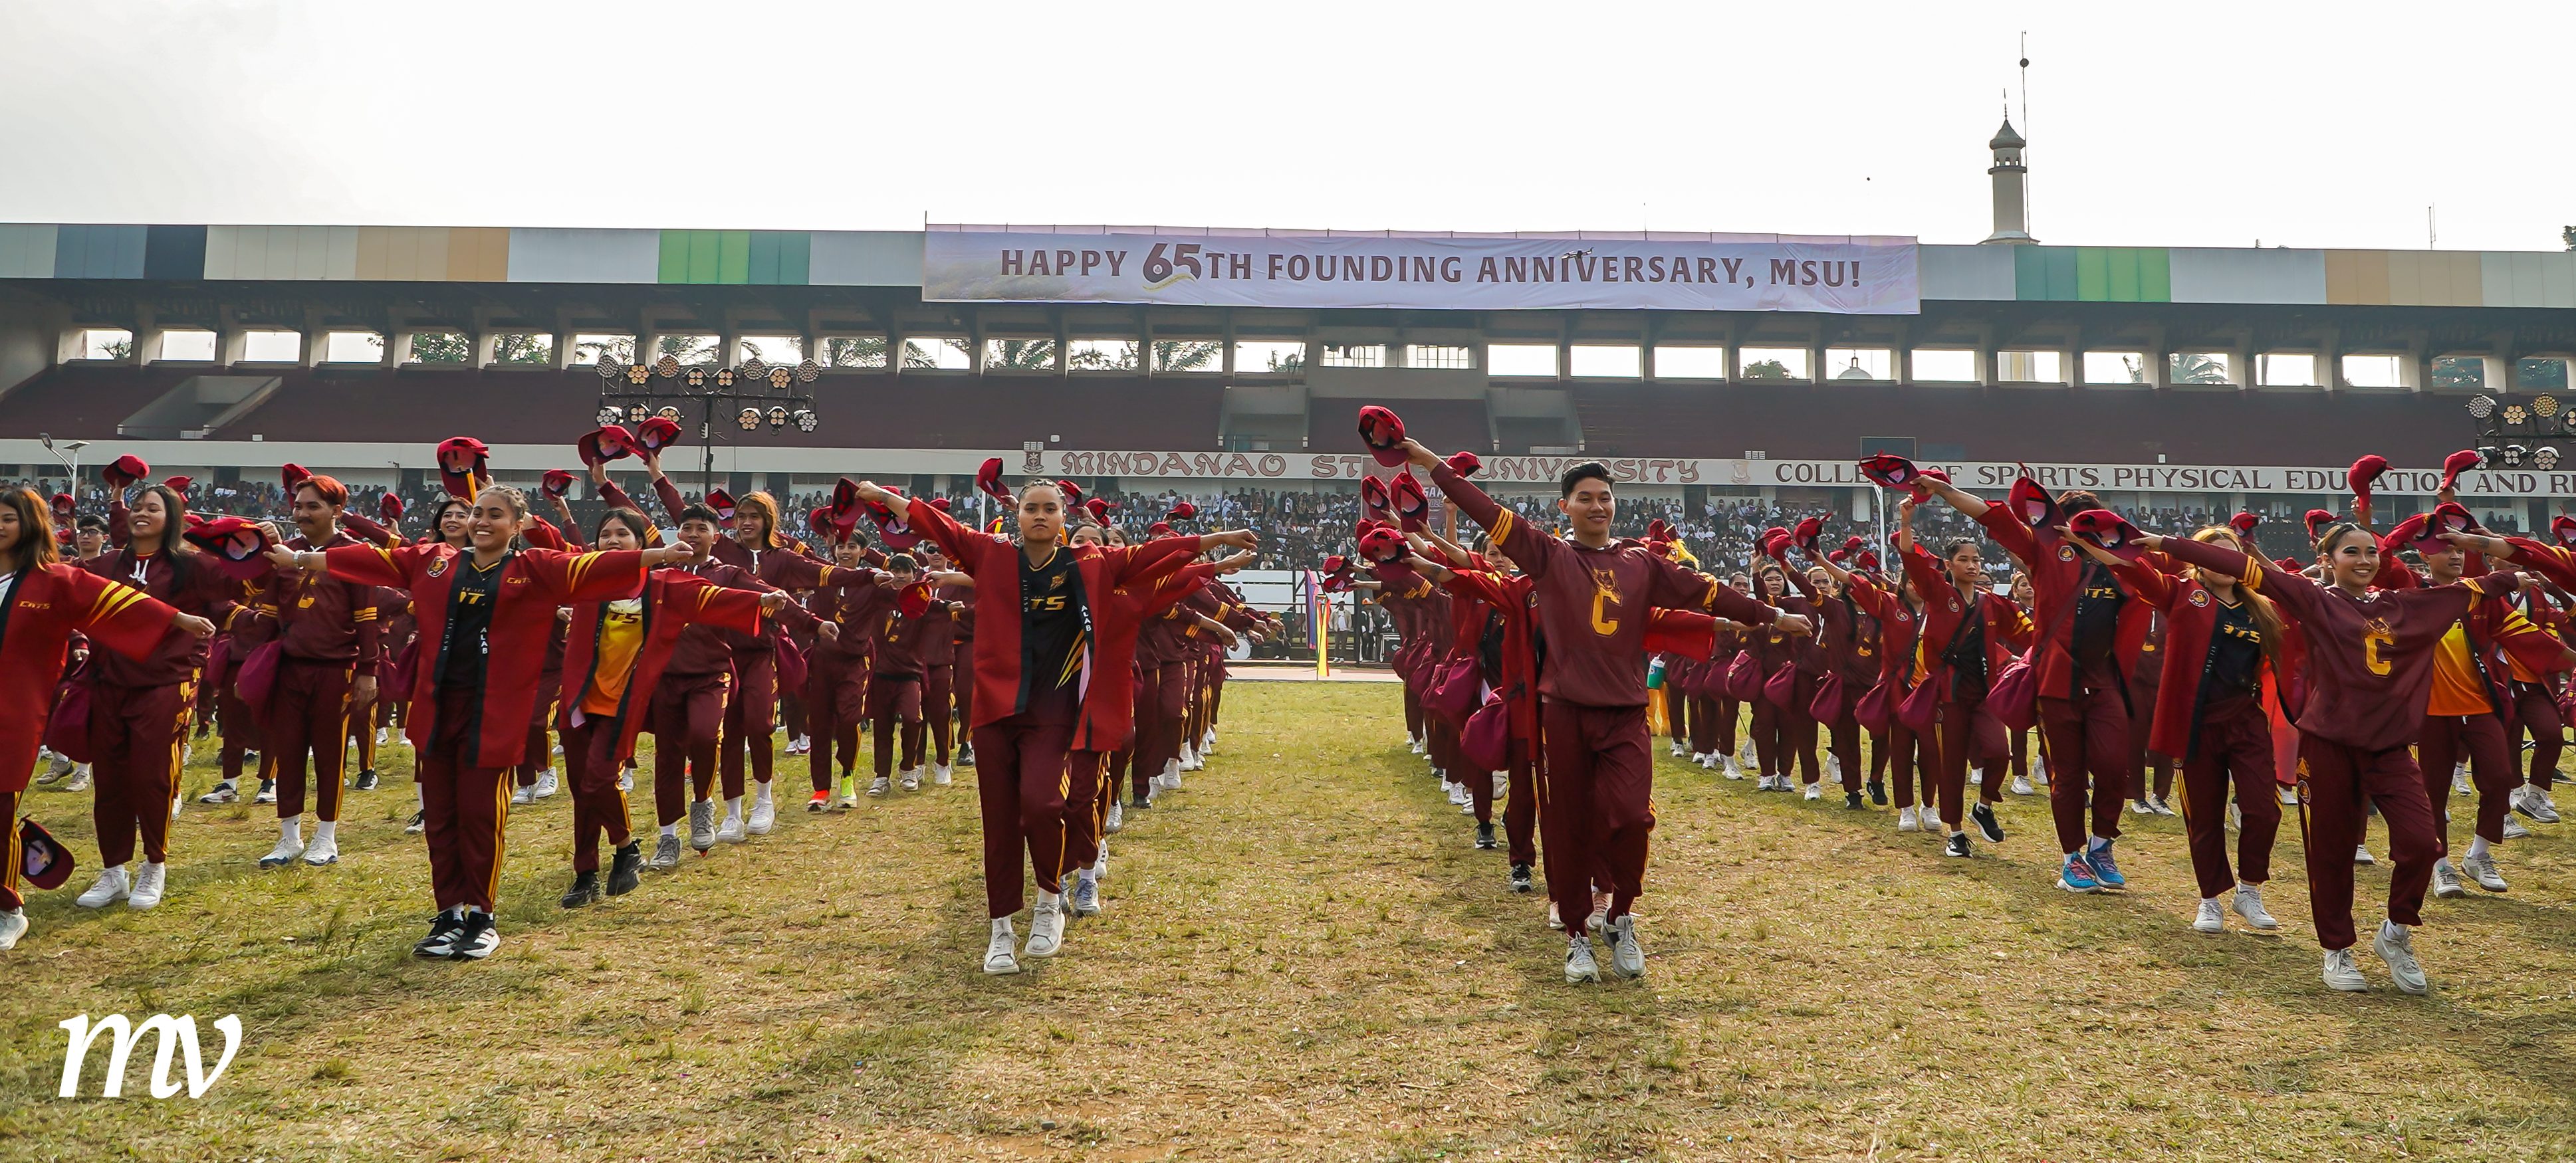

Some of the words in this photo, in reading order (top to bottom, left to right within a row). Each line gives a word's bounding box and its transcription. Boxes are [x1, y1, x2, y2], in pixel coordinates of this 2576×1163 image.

[1002, 249, 1128, 276] HAPPY
[1143, 243, 1252, 284] 65TH
[1268, 254, 1462, 282] FOUNDING
[1476, 256, 1755, 289] ANNIVERSARY,
[1770, 259, 1861, 288] MSU!
[1060, 451, 1286, 477] MINDANAO
[1775, 463, 1871, 483] COLLE
[2113, 468, 2272, 490] PHYSICAL
[2473, 473, 2537, 493] AND
[1080, 605, 1092, 632] ALAB
[479, 627, 489, 655] ALAB
